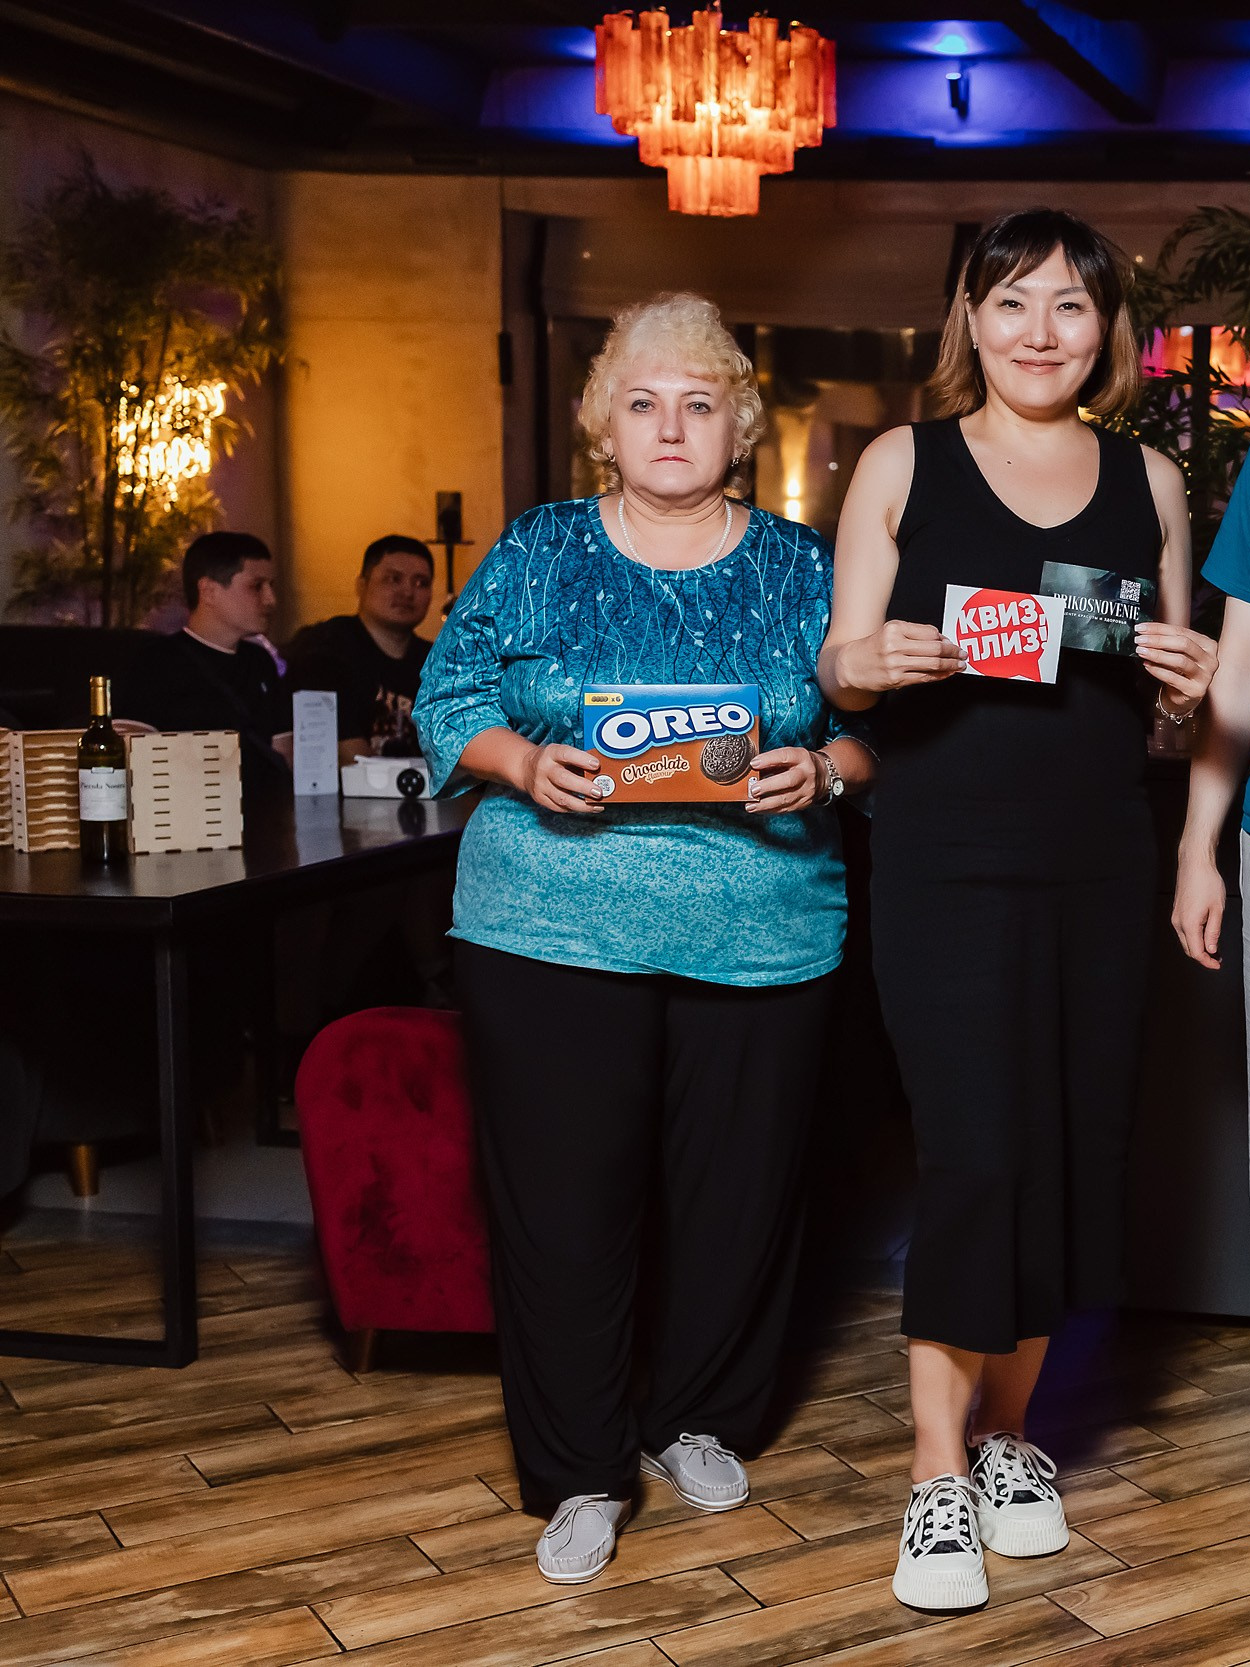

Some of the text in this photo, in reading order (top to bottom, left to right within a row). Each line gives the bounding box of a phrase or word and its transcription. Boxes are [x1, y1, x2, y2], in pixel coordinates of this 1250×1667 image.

[958, 599, 1046, 635] КВИЗ,
[959, 626, 1048, 662] ПЛИЗ!
[601, 704, 751, 750] OREO
[622, 755, 690, 783] Chocolate
